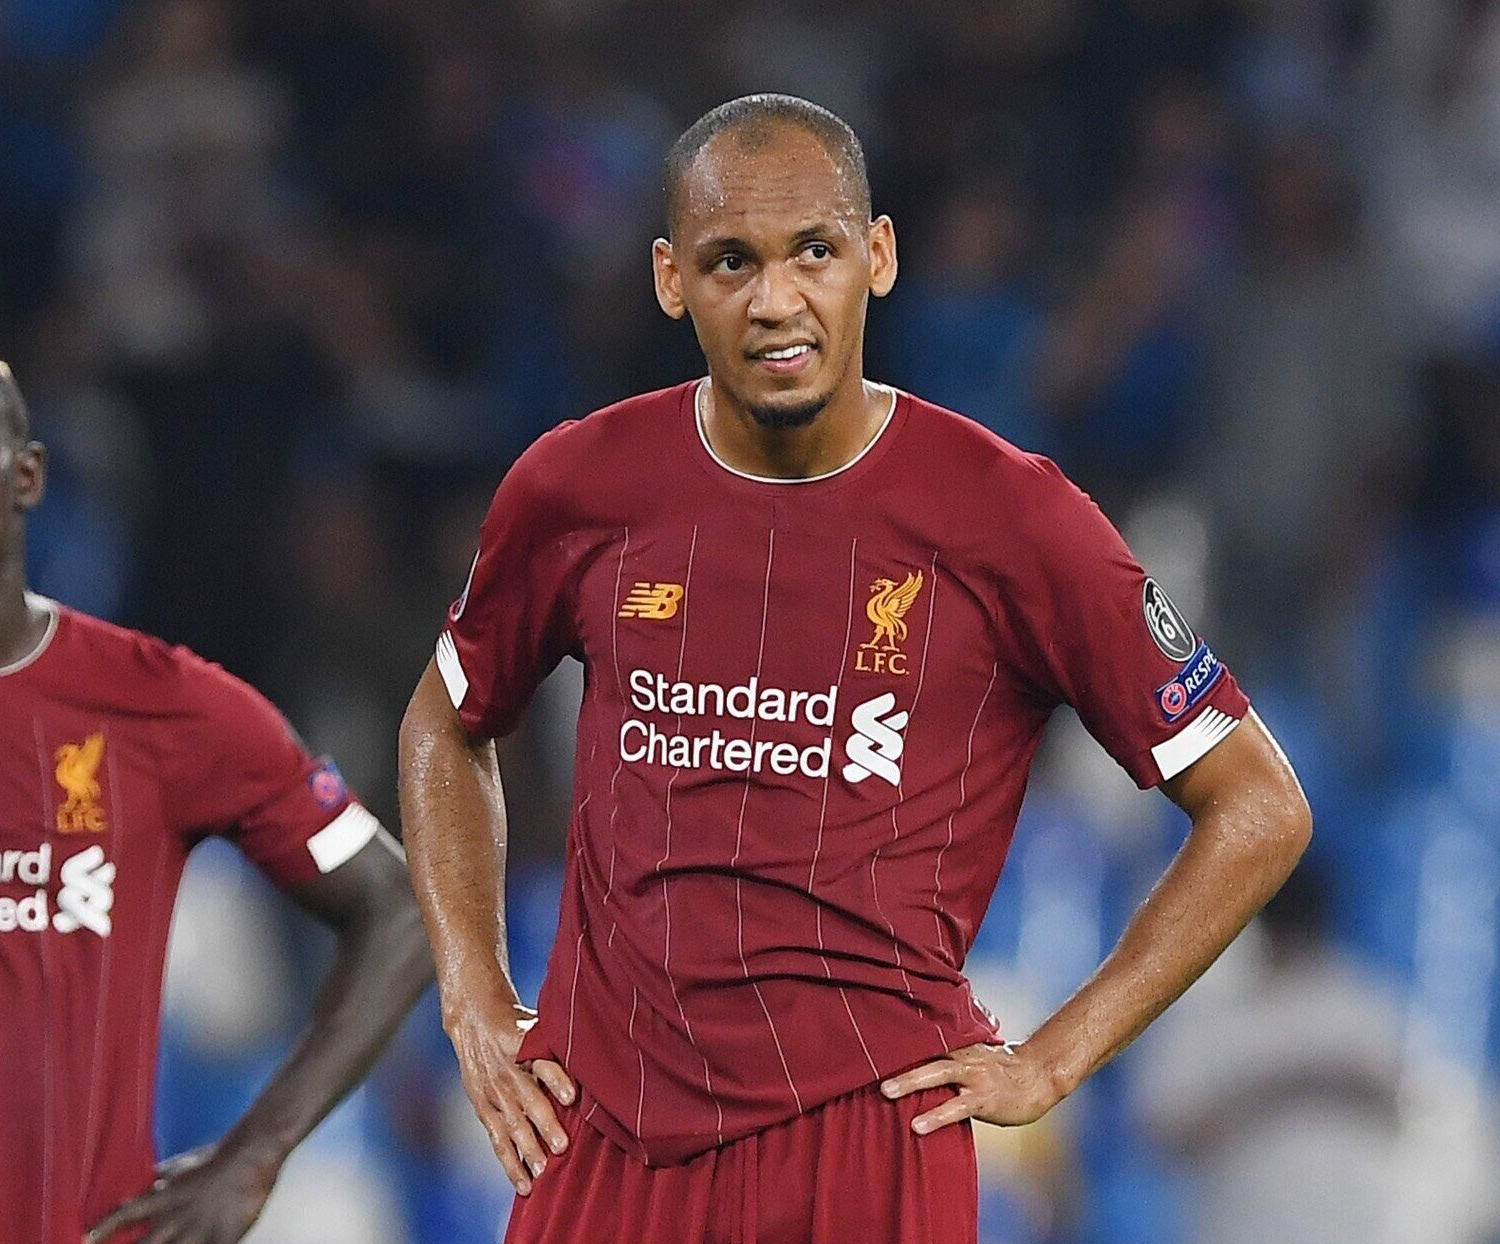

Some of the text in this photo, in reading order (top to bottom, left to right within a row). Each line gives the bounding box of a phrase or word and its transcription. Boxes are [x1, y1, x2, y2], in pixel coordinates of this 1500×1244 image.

[1161, 618, 1175, 640] 6
[628, 669, 838, 727] Standard
[619, 719, 832, 779] Chartered
